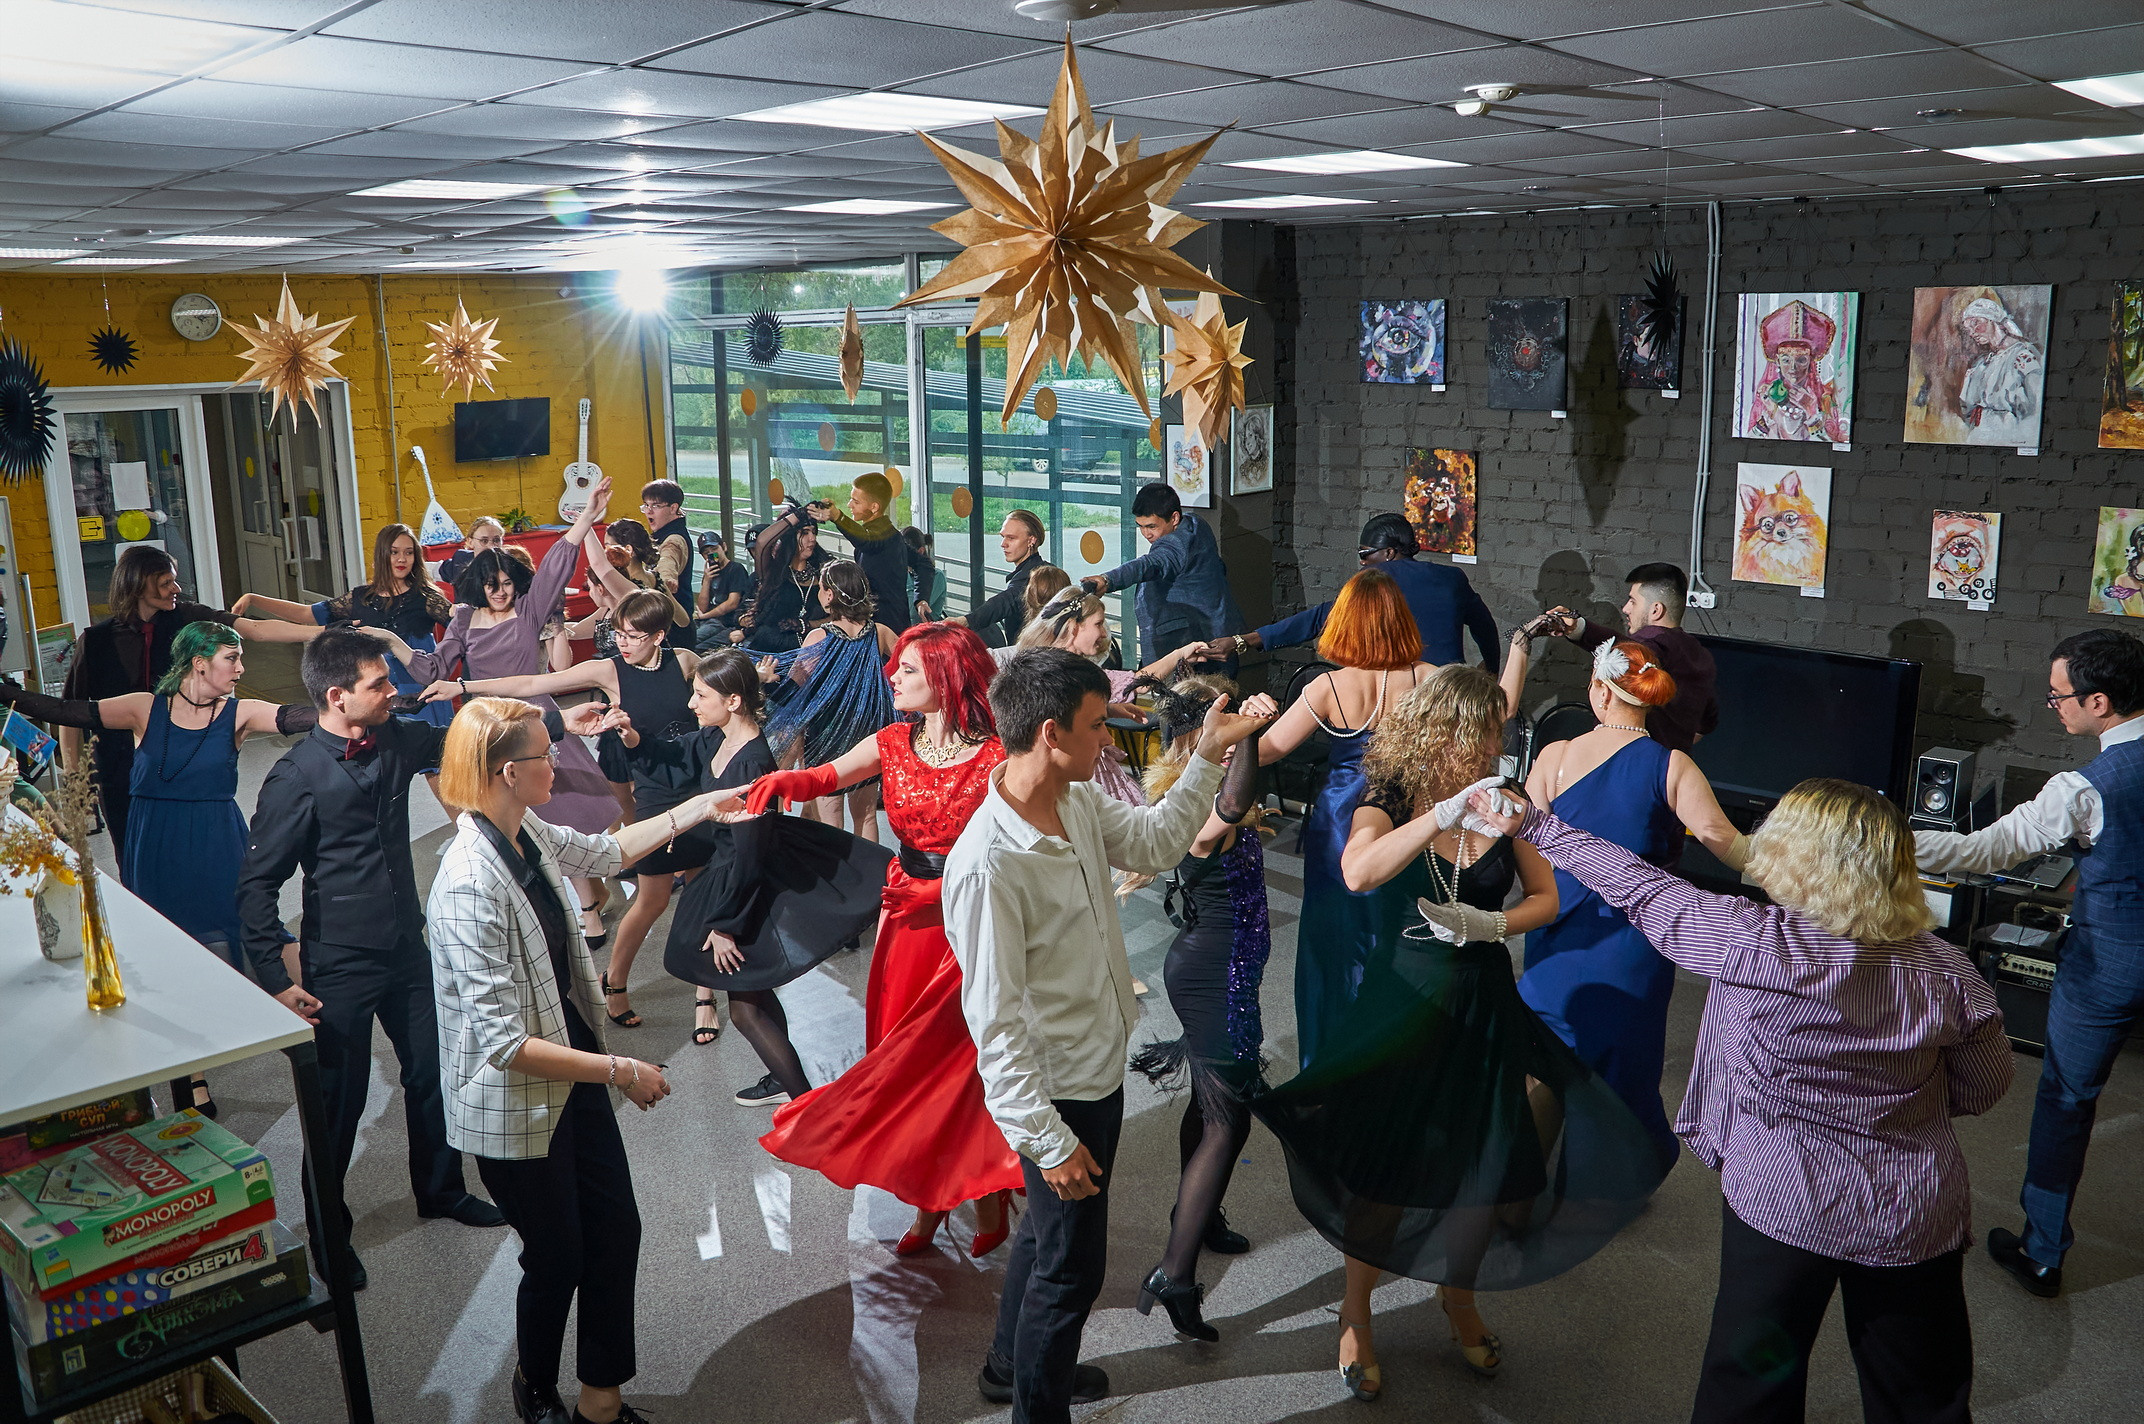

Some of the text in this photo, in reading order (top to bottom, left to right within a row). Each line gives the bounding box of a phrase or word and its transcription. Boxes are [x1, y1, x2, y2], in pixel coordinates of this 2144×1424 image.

[79, 1112, 106, 1128] СУП
[98, 1139, 183, 1190] MONOPOLY
[115, 1189, 211, 1238] MONOPOLY
[159, 1234, 264, 1288] СОБЕРИ 4
